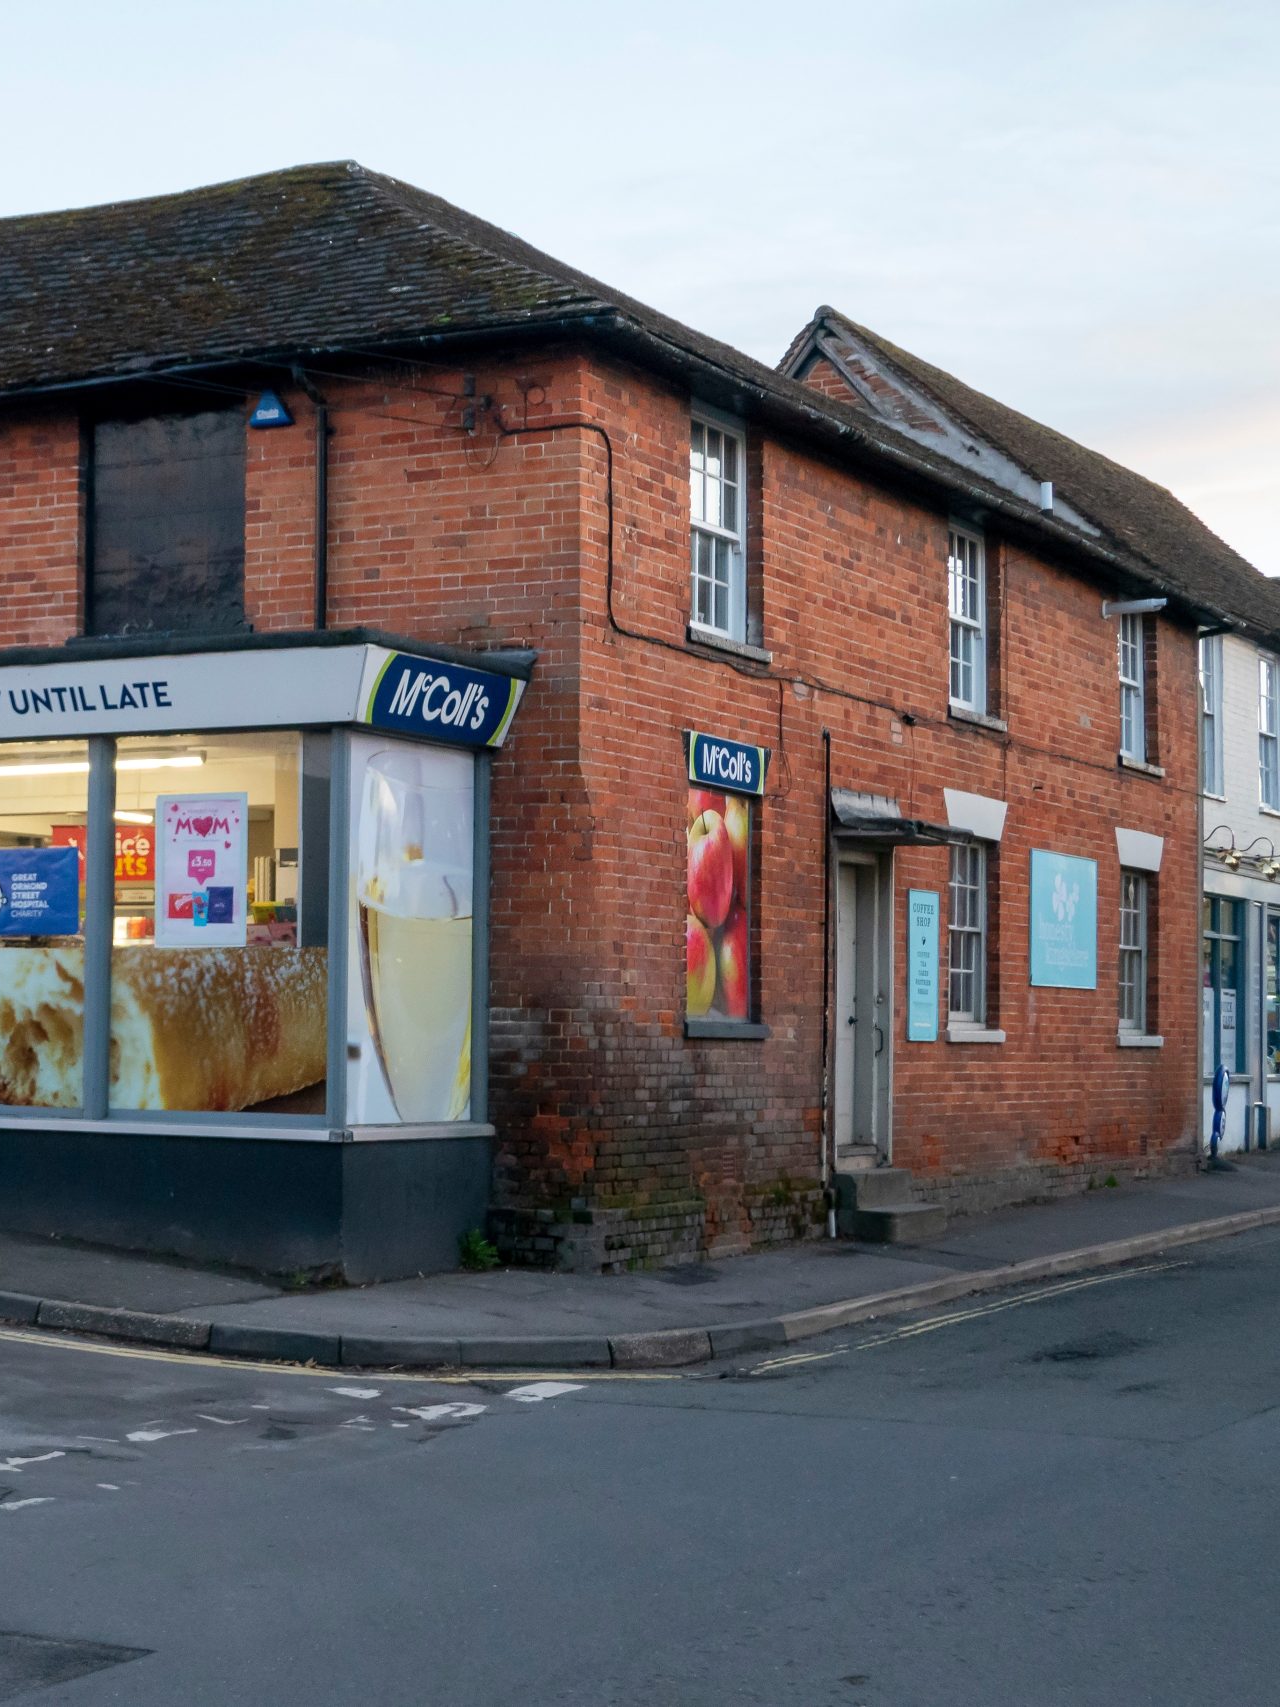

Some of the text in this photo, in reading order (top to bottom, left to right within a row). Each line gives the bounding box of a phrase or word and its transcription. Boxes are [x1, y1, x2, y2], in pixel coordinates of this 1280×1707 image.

[9, 686, 96, 715] UNTIL
[99, 681, 172, 710] LATE
[388, 668, 490, 730] McColl's
[702, 743, 752, 784] McColl's
[115, 832, 151, 856] ice
[11, 873, 37, 881] GREAT
[11, 882, 48, 890] ORMOND
[11, 891, 40, 900] STREET
[10, 900, 50, 909] HOSPITAL
[912, 902, 935, 915] COFFEE
[10, 909, 43, 918] CHARITY
[916, 916, 931, 928] SHOP
